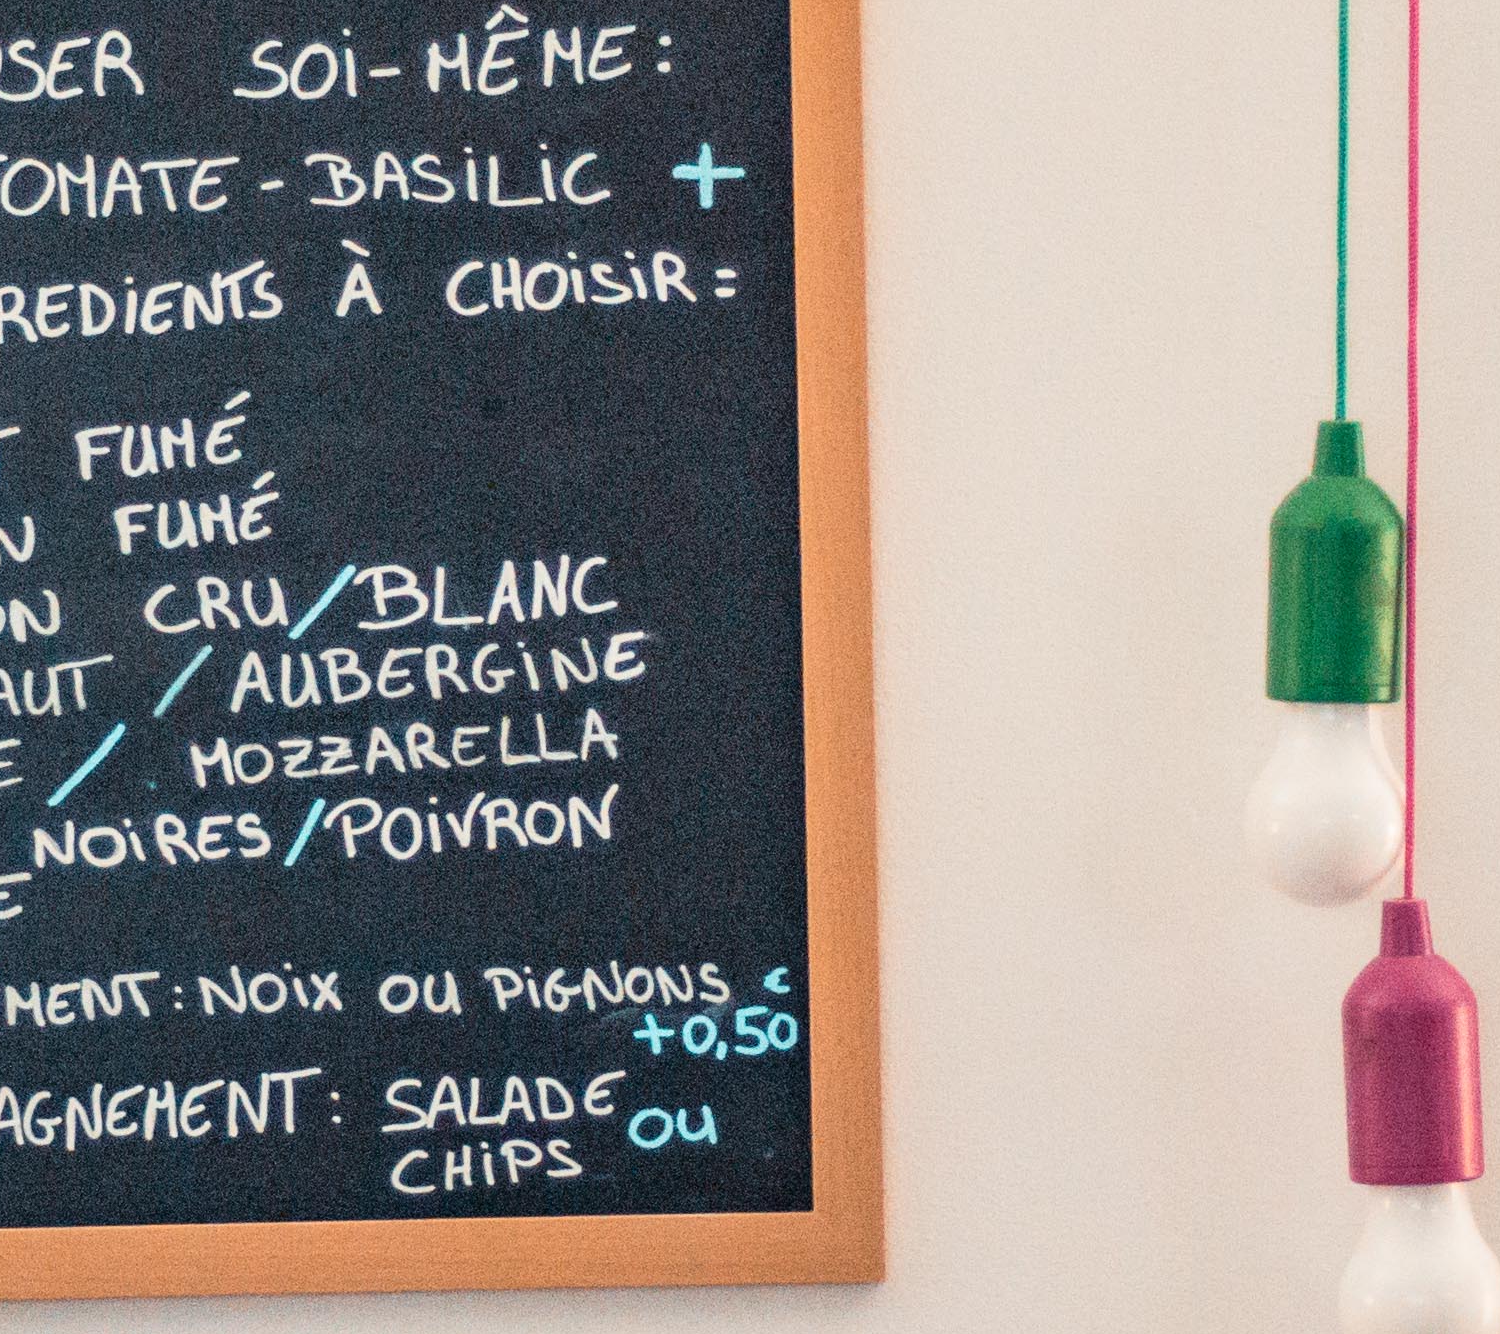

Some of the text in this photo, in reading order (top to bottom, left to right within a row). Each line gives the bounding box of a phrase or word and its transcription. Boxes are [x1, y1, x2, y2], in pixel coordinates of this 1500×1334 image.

[334, 238, 383, 318] À
[73, 390, 251, 481] FUMÉ
[112, 470, 280, 556] FUMÉ
[188, 706, 619, 789] MOZZARELLA
[377, 970, 463, 1015] OU
[381, 1069, 626, 1134] SALADE
[627, 1104, 719, 1150] OU
